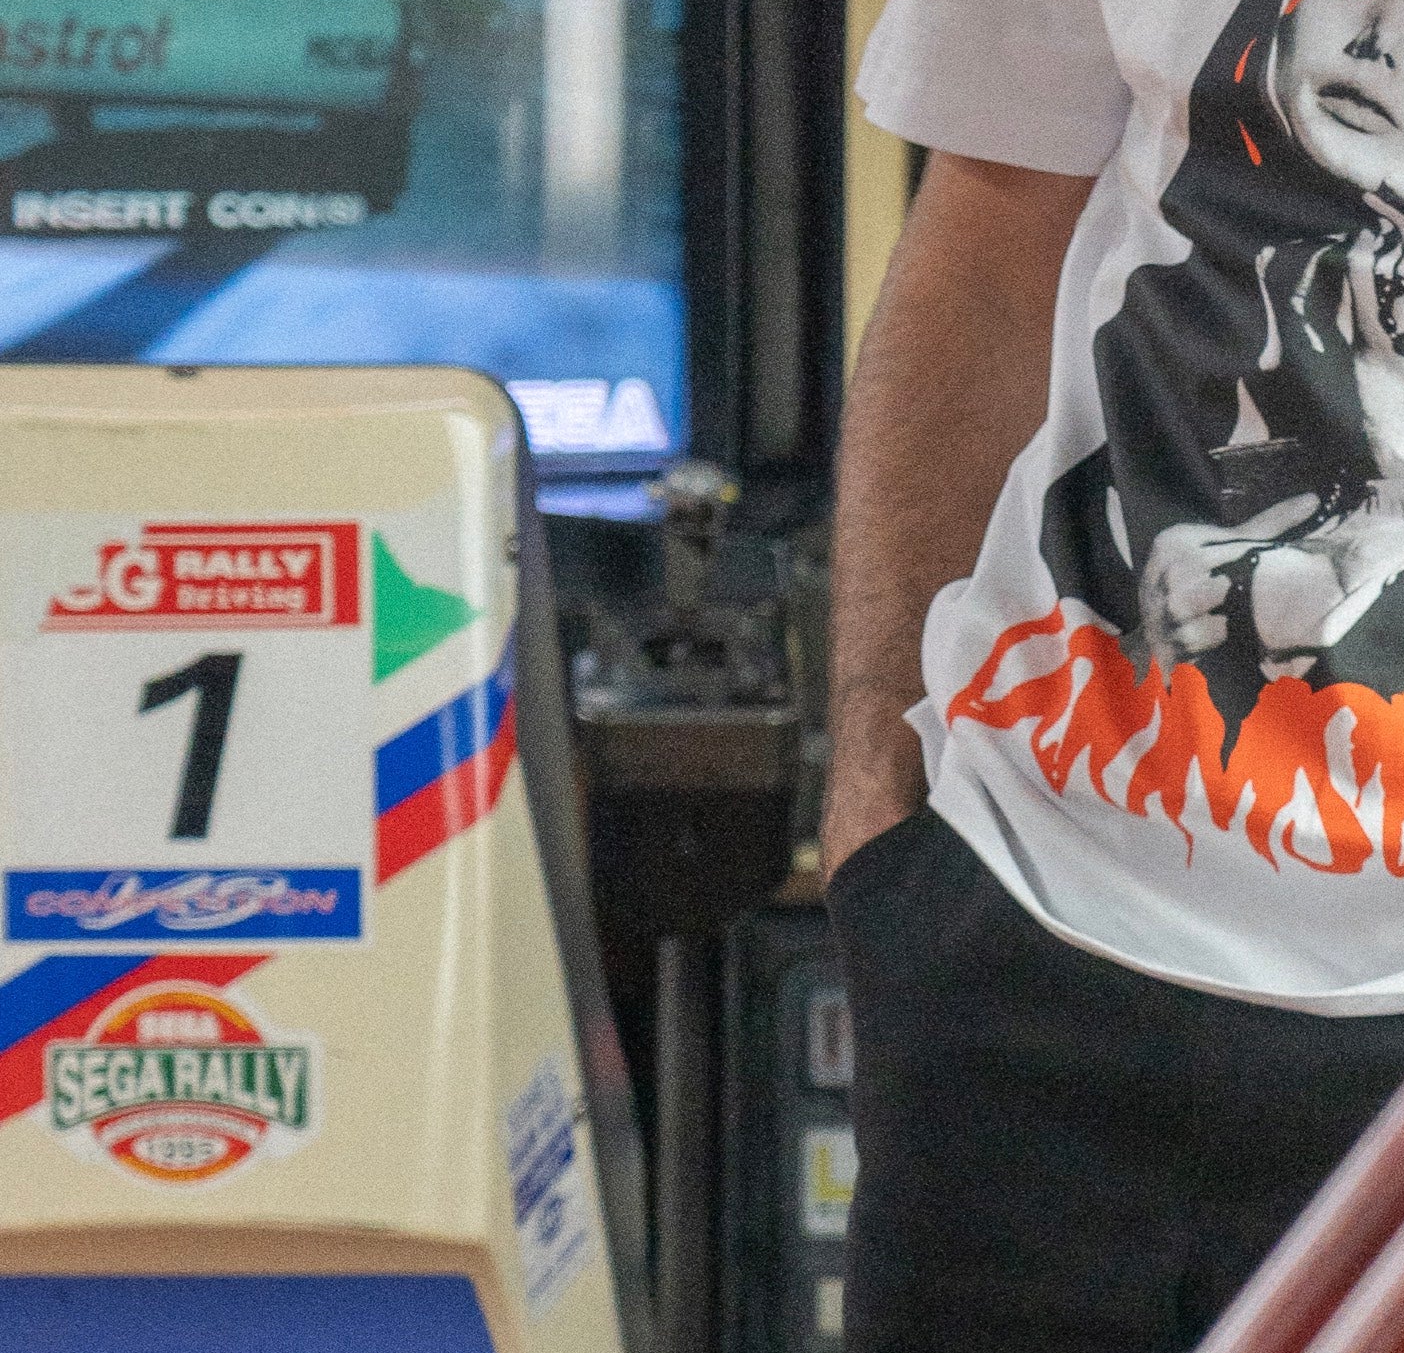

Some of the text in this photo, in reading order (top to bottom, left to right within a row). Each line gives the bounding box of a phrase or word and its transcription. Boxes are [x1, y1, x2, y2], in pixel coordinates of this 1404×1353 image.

[0, 14, 174, 74] strol
[12, 190, 189, 230] INSERT
[173, 549, 314, 581] RALLY
[138, 652, 245, 840] 1
[55, 1049, 167, 1124] SEGA
[174, 1049, 302, 1123] RALLY
